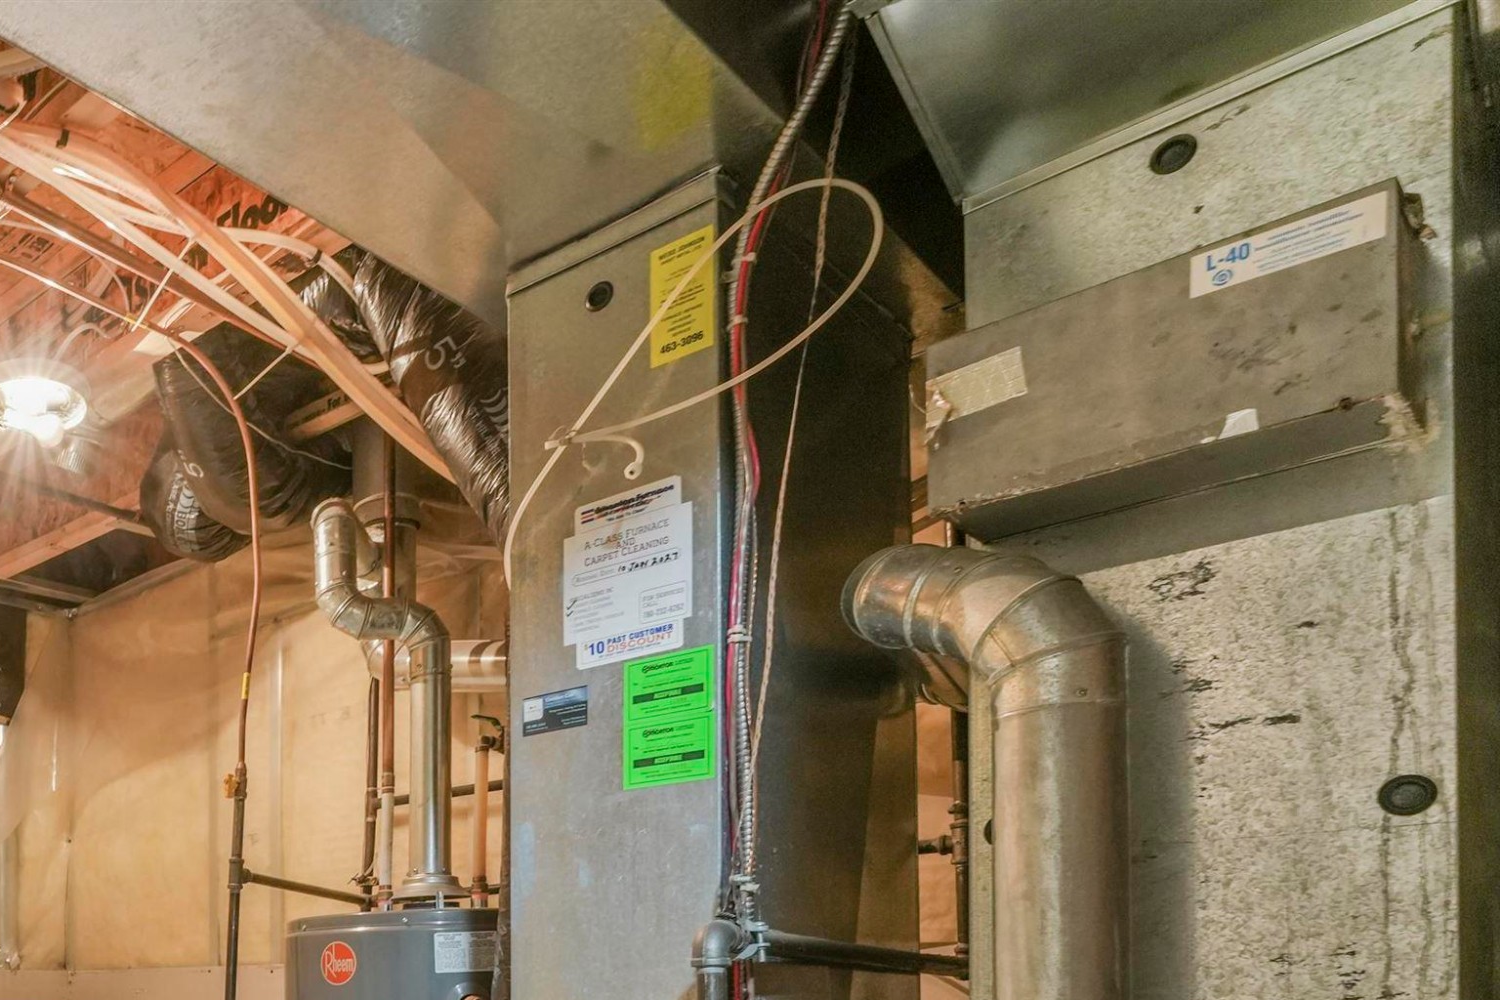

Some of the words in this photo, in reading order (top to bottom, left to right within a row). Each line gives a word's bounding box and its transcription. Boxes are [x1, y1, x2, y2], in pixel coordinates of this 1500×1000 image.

[1206, 242, 1251, 271] L-40
[625, 518, 670, 538] FURNACE
[584, 550, 620, 567] CARPET
[621, 536, 669, 556] CLEANING
[616, 537, 636, 550] AND
[607, 634, 626, 644] PAST
[629, 623, 673, 640] CUSTOMER
[607, 631, 673, 653] DISCOUNT
[323, 942, 355, 978] Rheem
